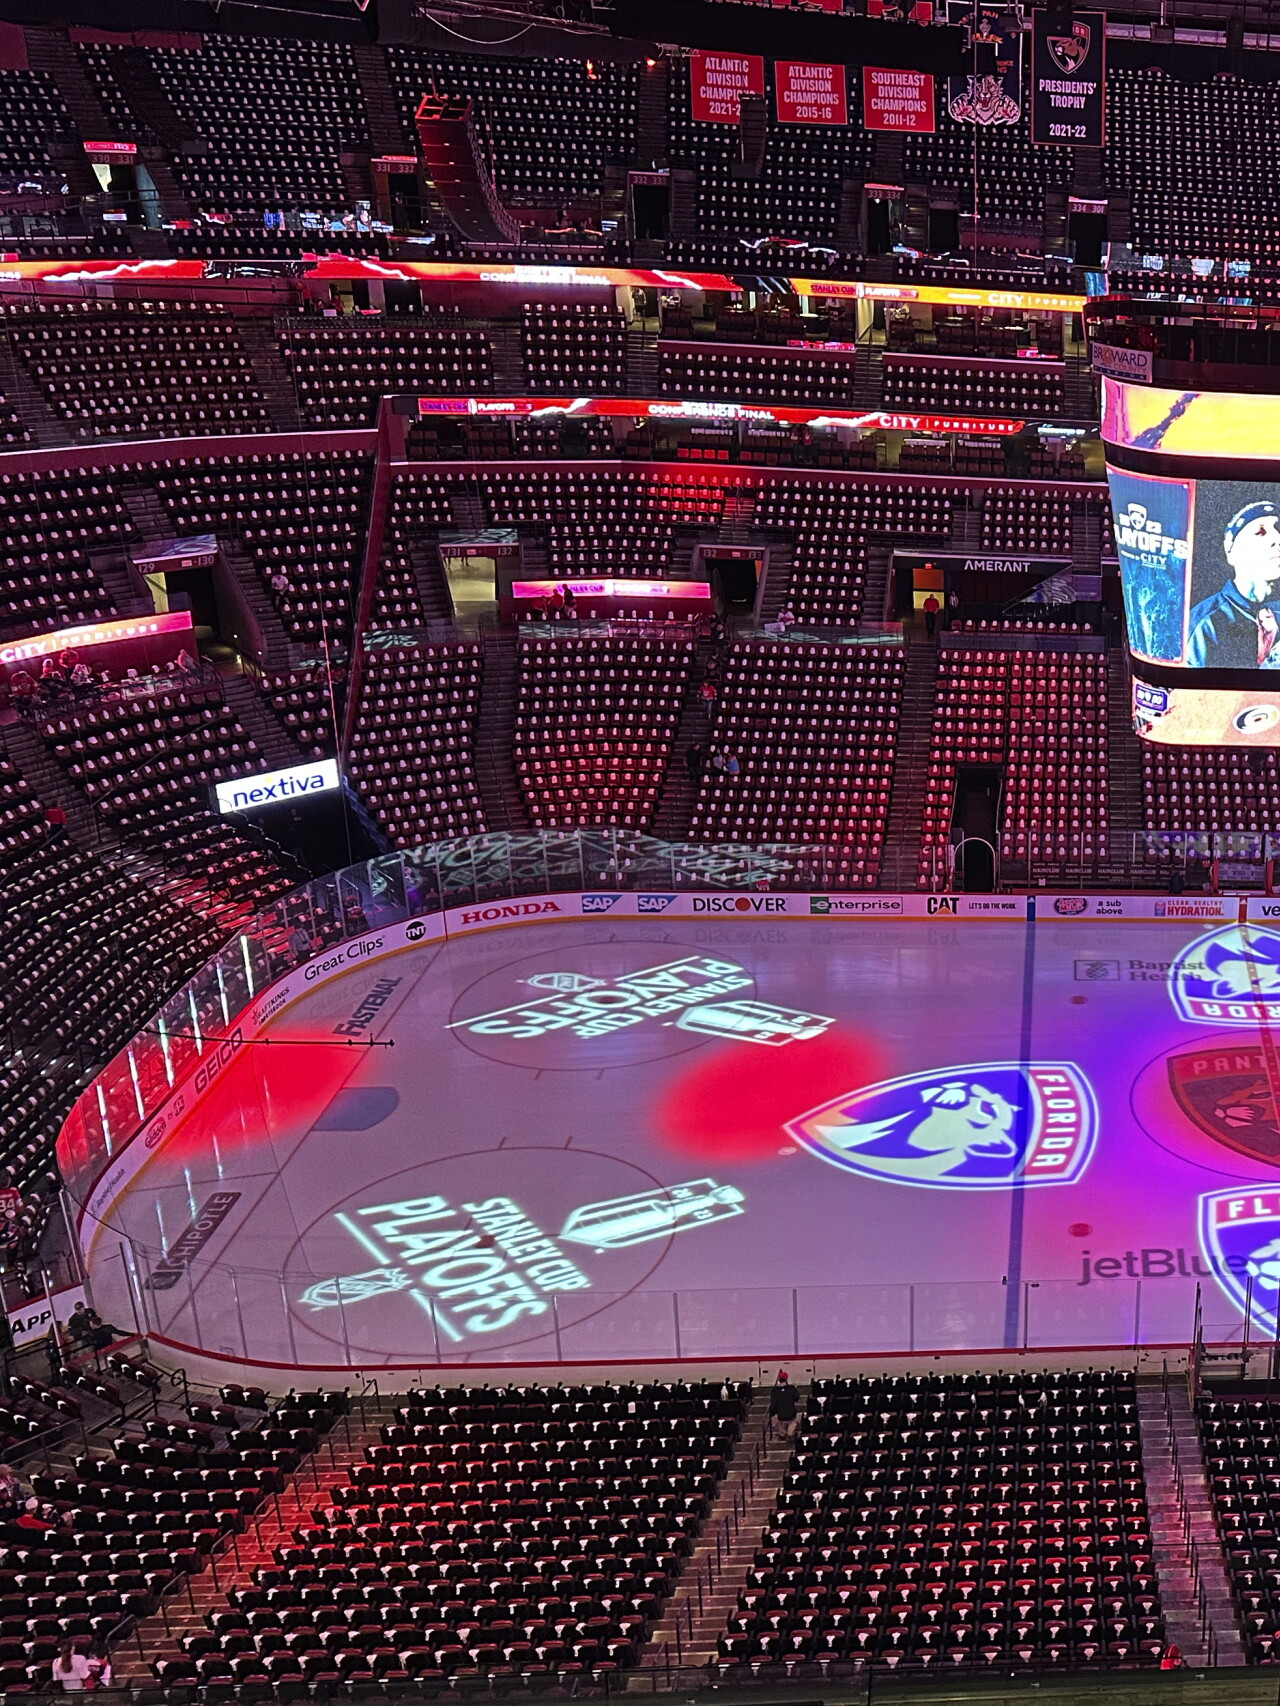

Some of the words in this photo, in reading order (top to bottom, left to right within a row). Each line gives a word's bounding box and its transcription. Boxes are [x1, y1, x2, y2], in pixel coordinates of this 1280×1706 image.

[705, 56, 749, 74] ATLANTIC
[788, 65, 833, 80] ATLANTIC
[706, 71, 749, 87] DIVISION
[790, 78, 831, 93] DIVISION
[871, 72, 926, 87] SOUTHEAST
[1039, 78, 1097, 95] PRESIDENTS'
[783, 90, 839, 106] CHAMPIONS
[878, 85, 921, 100] DIVISION
[709, 101, 741, 116] 2021-2
[871, 97, 927, 113] CHAMPIONS
[1050, 94, 1087, 110] TROPHY
[796, 105, 832, 119] 2015-16
[883, 112, 917, 127] 2011-12
[1049, 123, 1087, 138] 2021-22
[1072, 204, 1086, 212] 334
[988, 292, 1024, 306] CITY
[1094, 346, 1148, 367] BROWARD
[738, 409, 775, 420] FINAL
[880, 415, 920, 428] CITY
[934, 420, 1013, 432] FURNITURE
[447, 548, 460, 556] 131
[498, 547, 513, 556] 132
[703, 549, 717, 557] 132
[138, 563, 155, 573] 129
[198, 555, 215, 566] 130
[964, 560, 1031, 572] AMERANT
[1, 641, 46, 662] CITY
[61, 624, 158, 646] FURNITURE
[233, 775, 325, 807] nextiva
[583, 898, 613, 910] SAP
[638, 898, 669, 910] SAP
[692, 897, 788, 912] DISCOVER
[816, 899, 901, 912] enterprise
[927, 897, 960, 915] CAT
[1106, 899, 1121, 907] sub
[1168, 906, 1224, 916] HYDRATION.
[461, 901, 562, 925] HONDA
[406, 926, 427, 938] TNT
[304, 954, 345, 980] Great
[346, 938, 384, 958] Clips
[1129, 959, 1206, 972] Baptist
[1129, 971, 1202, 981] Health
[469, 958, 744, 1038] PLAYOFFS
[641, 974, 753, 1015] STANLEY
[332, 977, 404, 1037] FASTENAL
[575, 1011, 643, 1038] CUP
[195, 1027, 242, 1095] GEICO
[1031, 1074, 1077, 1167] FLORIDA
[169, 1194, 233, 1267] CHIPOTLE
[461, 1197, 563, 1263] STANLEY
[526, 1258, 588, 1291] CUP
[357, 1195, 548, 1334] PLAYOFFS
[1077, 1248, 1249, 1287] jetBlue
